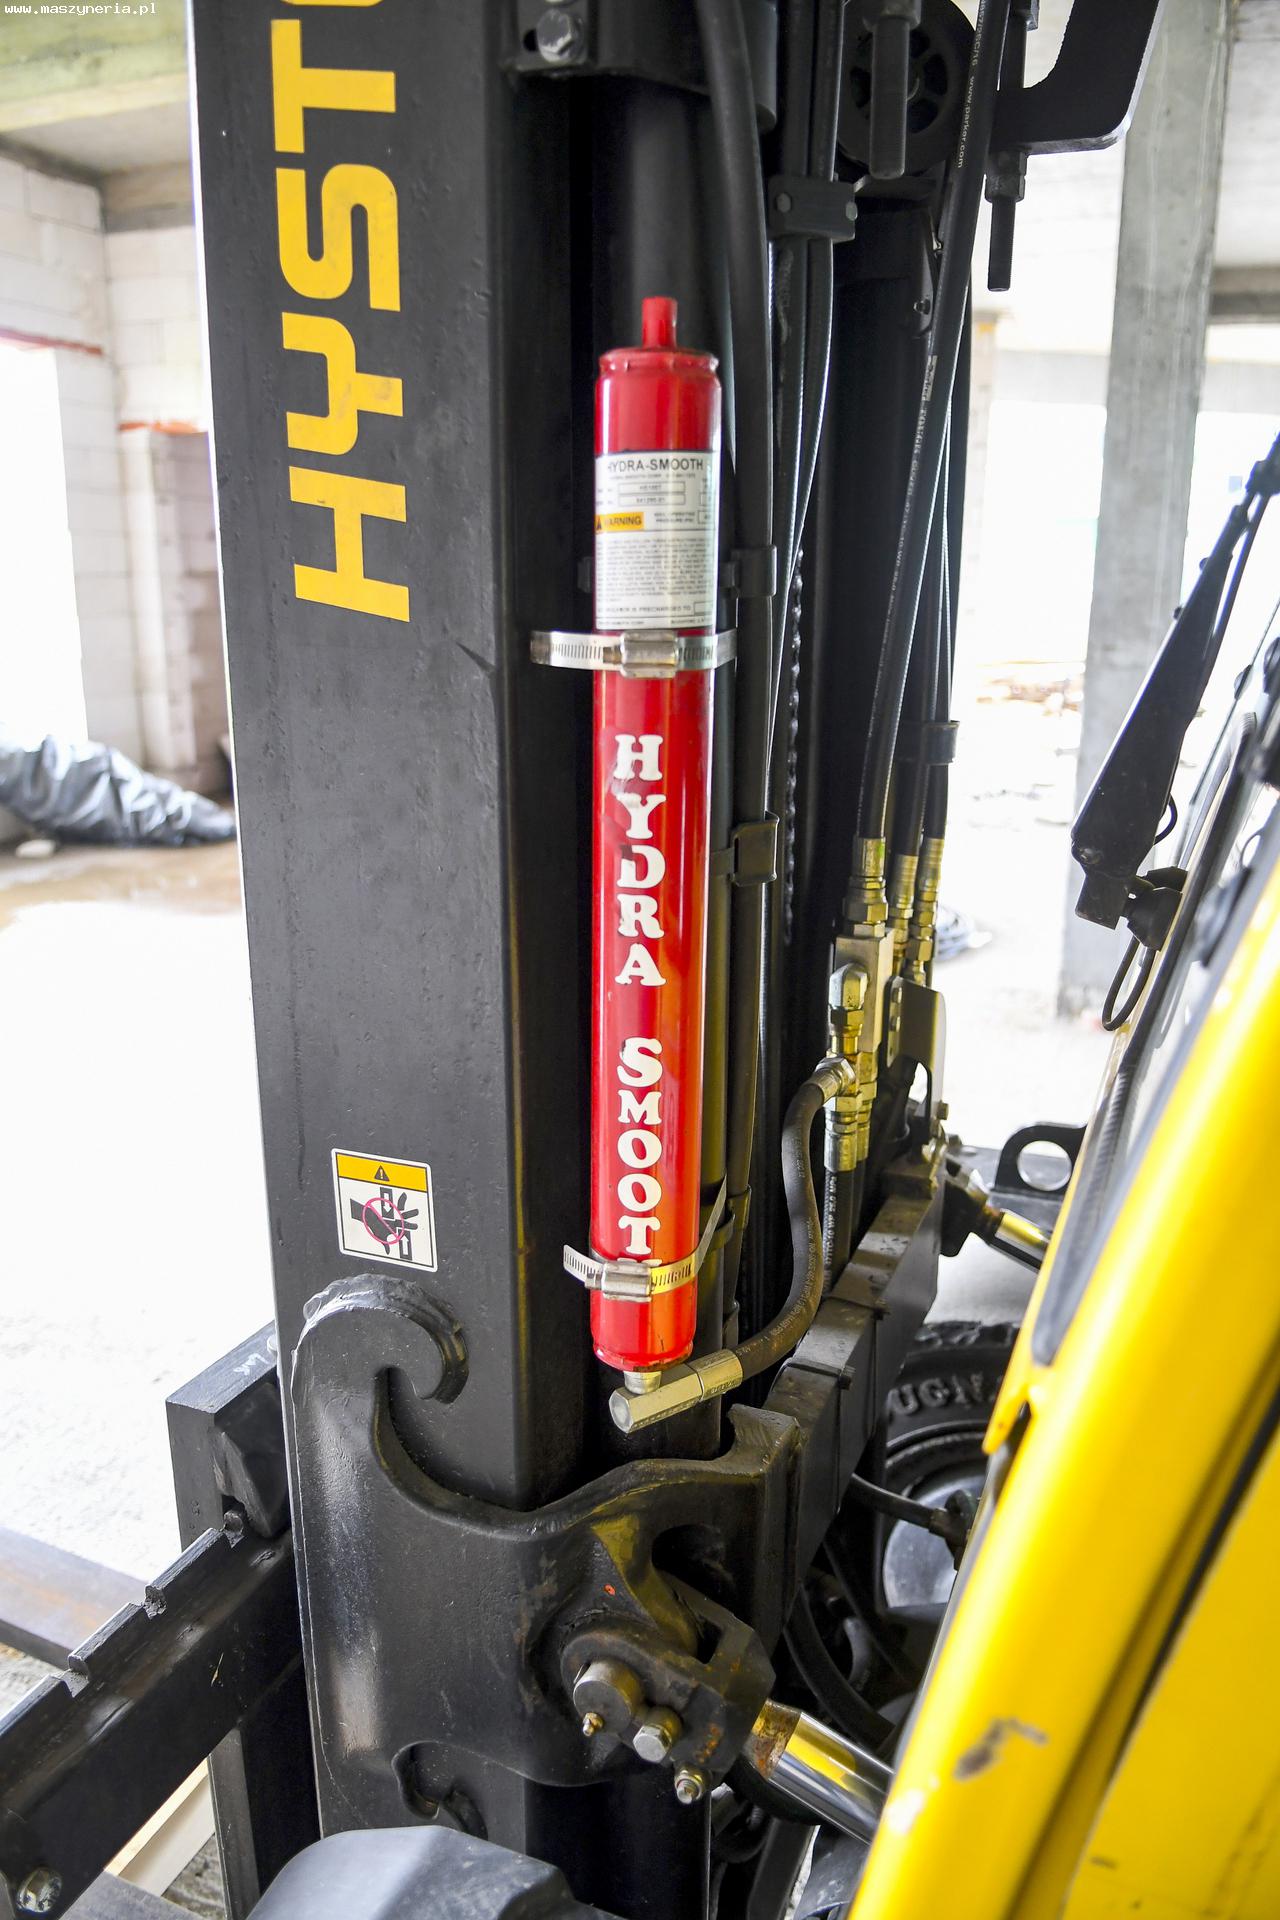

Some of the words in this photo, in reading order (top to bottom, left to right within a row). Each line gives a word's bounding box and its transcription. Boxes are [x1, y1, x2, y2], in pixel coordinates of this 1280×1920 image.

[271, 0, 410, 623] HYST
[613, 734, 667, 987] HYDRA
[616, 1037, 664, 1267] SMOOT
